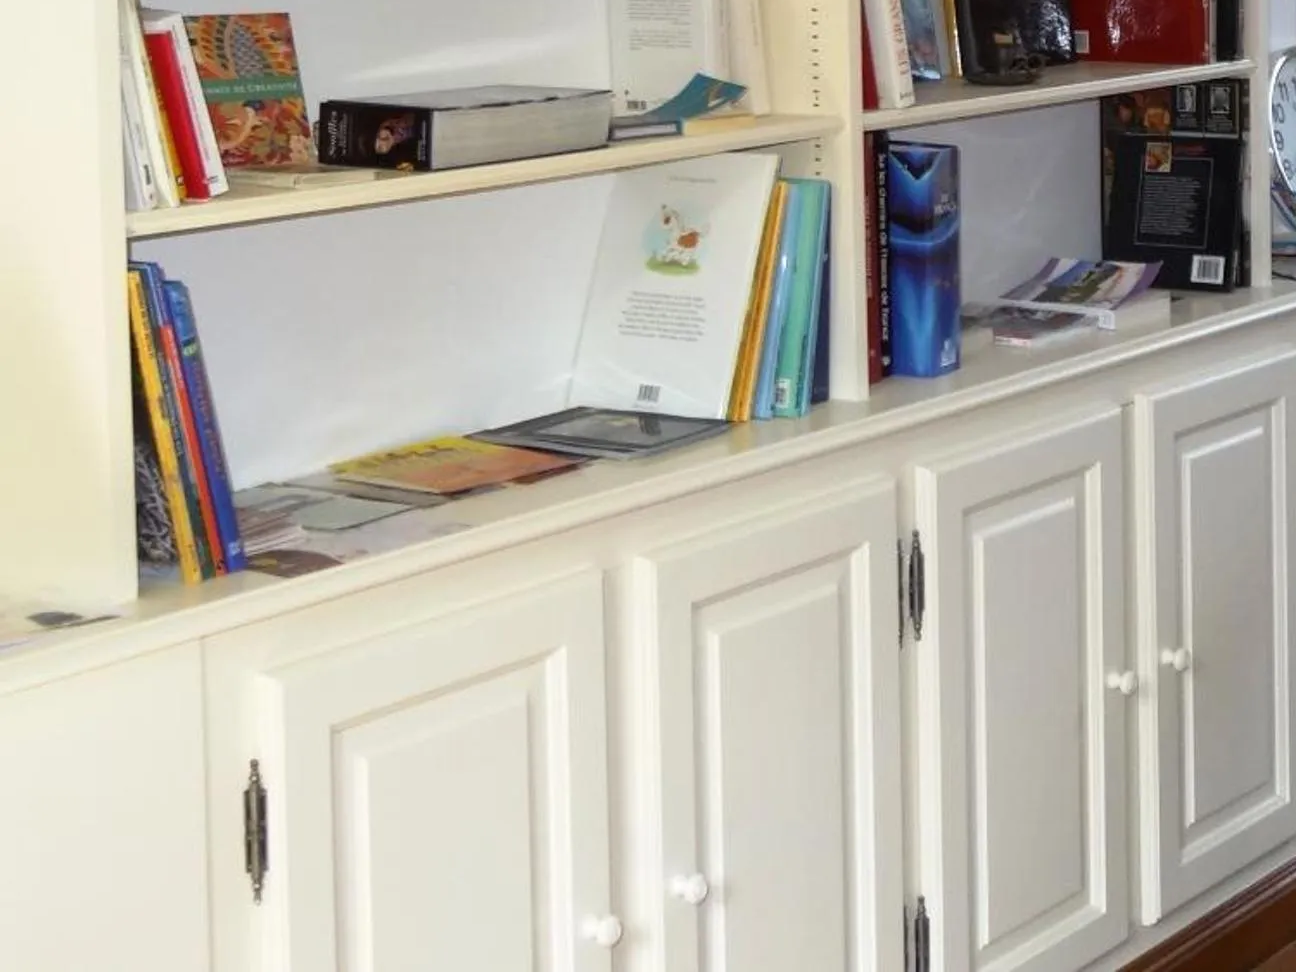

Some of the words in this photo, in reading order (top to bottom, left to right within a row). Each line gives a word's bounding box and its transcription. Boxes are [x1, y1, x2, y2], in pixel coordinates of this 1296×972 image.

[1278, 82, 1290, 101] 11
[1273, 104, 1285, 123] 10
[1274, 131, 1284, 150] 9
